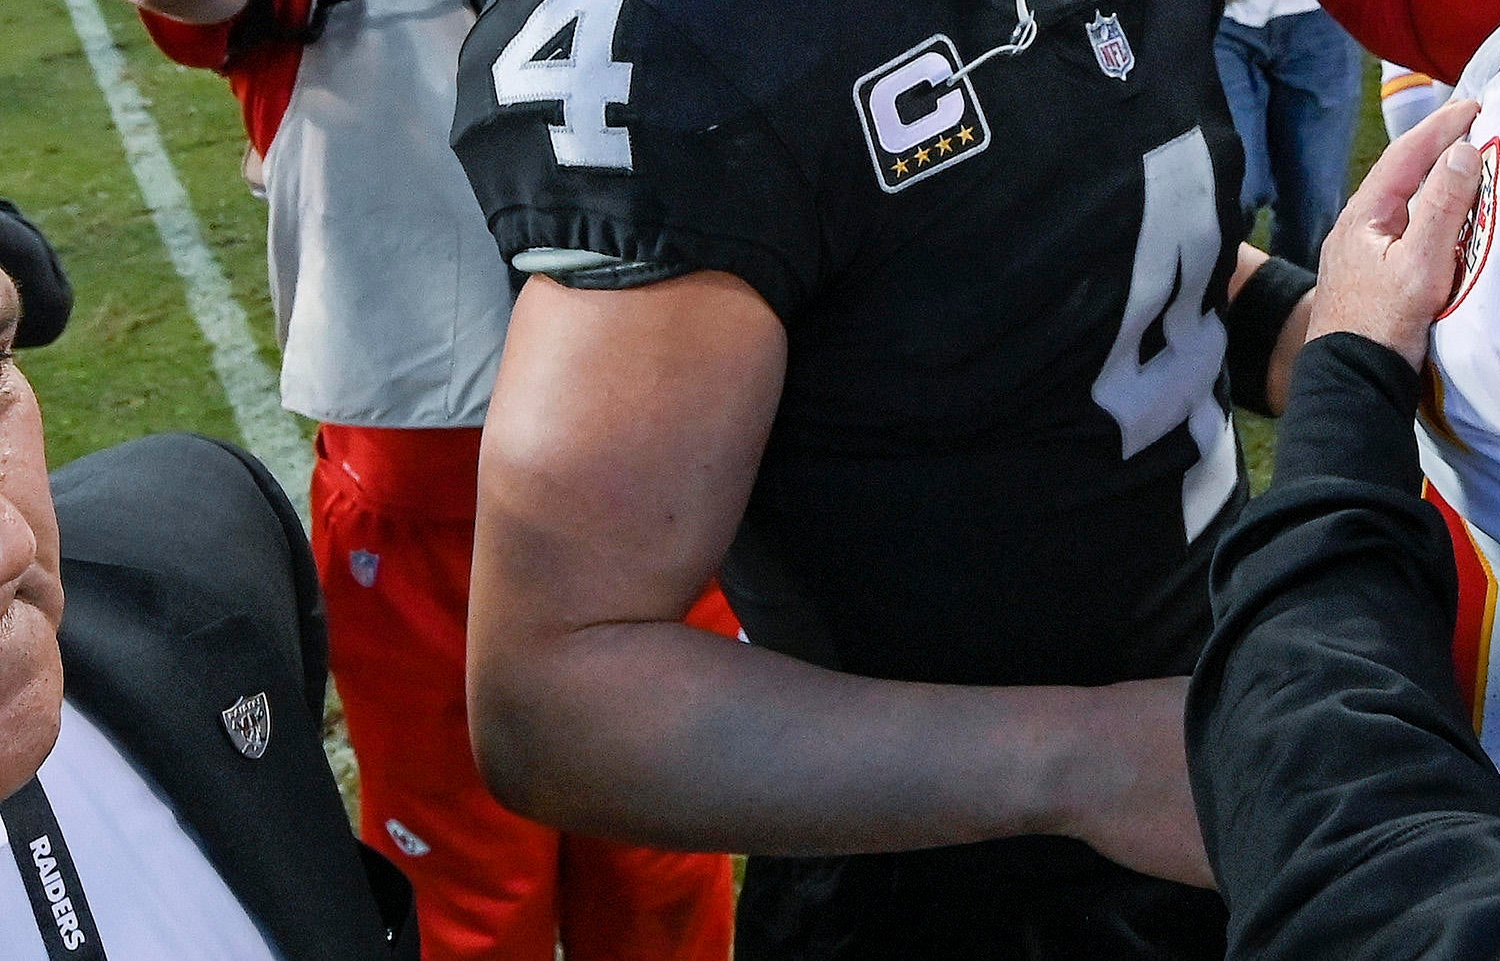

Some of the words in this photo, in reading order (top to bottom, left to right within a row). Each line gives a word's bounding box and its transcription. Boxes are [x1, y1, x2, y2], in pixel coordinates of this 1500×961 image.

[869, 50, 966, 155] C
[1092, 124, 1238, 544] 4
[29, 835, 86, 952] RAIDERS
